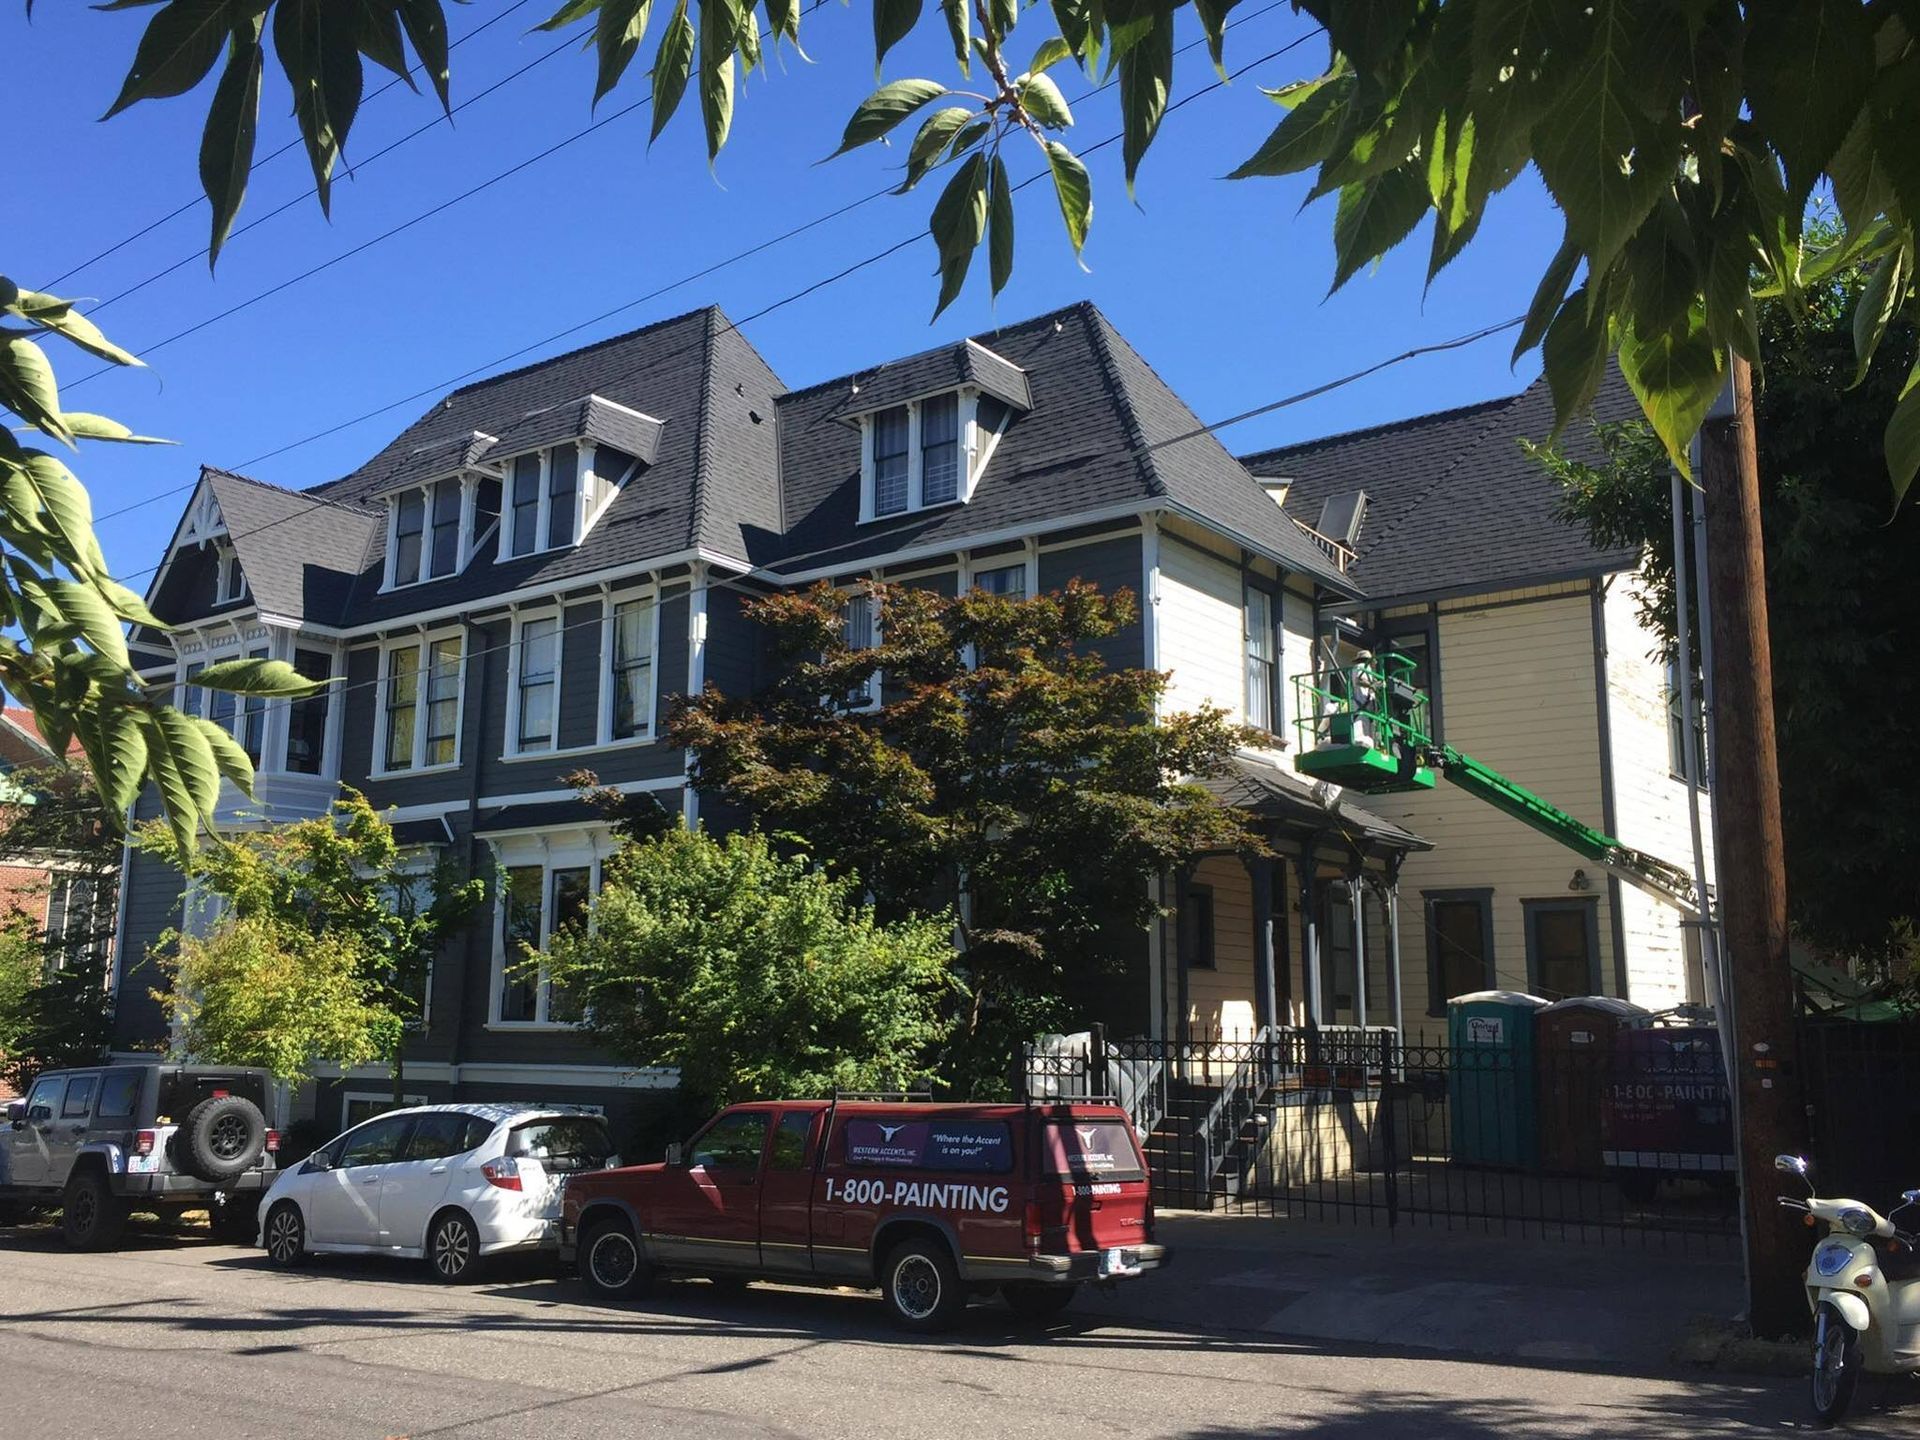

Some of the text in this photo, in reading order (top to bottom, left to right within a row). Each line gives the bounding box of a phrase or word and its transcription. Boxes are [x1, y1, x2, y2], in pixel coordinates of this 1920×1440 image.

[1613, 1084, 1729, 1101] 1-800-PAINTIN
[962, 1134, 975, 1144] the
[975, 1136, 1001, 1145] Accent
[853, 1146, 879, 1154] WESTERN
[941, 1145, 948, 1154] is
[949, 1147, 960, 1155] on
[826, 1178, 1009, 1213] 1-800-PAINTING
[1071, 1183, 1121, 1196] 1-800-PAINTING
